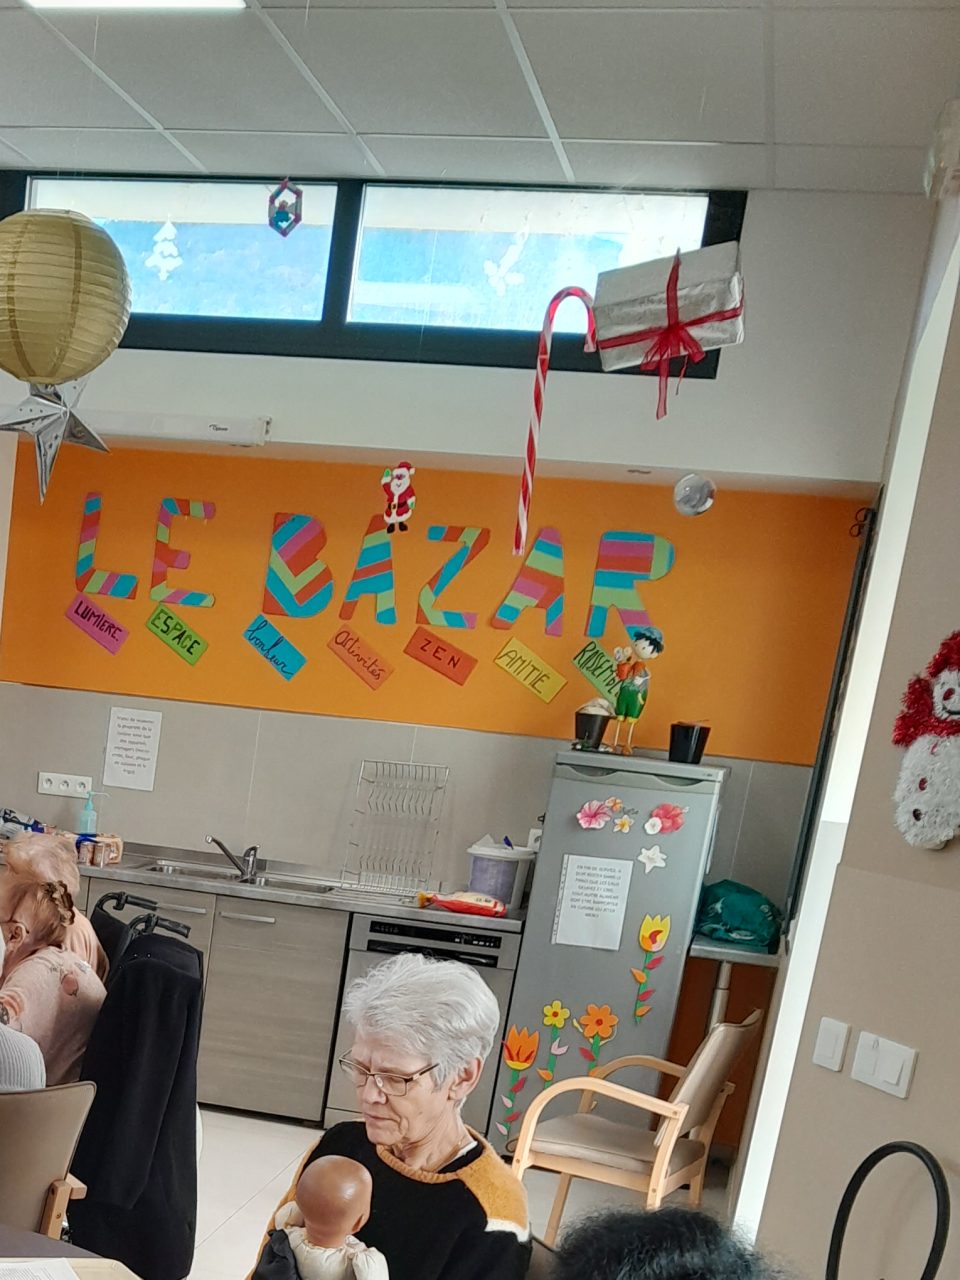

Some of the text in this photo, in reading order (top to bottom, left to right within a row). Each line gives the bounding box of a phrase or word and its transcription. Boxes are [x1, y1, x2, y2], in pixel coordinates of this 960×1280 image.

[76, 491, 675, 640] LE BAZAR
[151, 609, 200, 655] ESPACE
[247, 619, 294, 676] bonheur
[420, 638, 460, 669] ZEN
